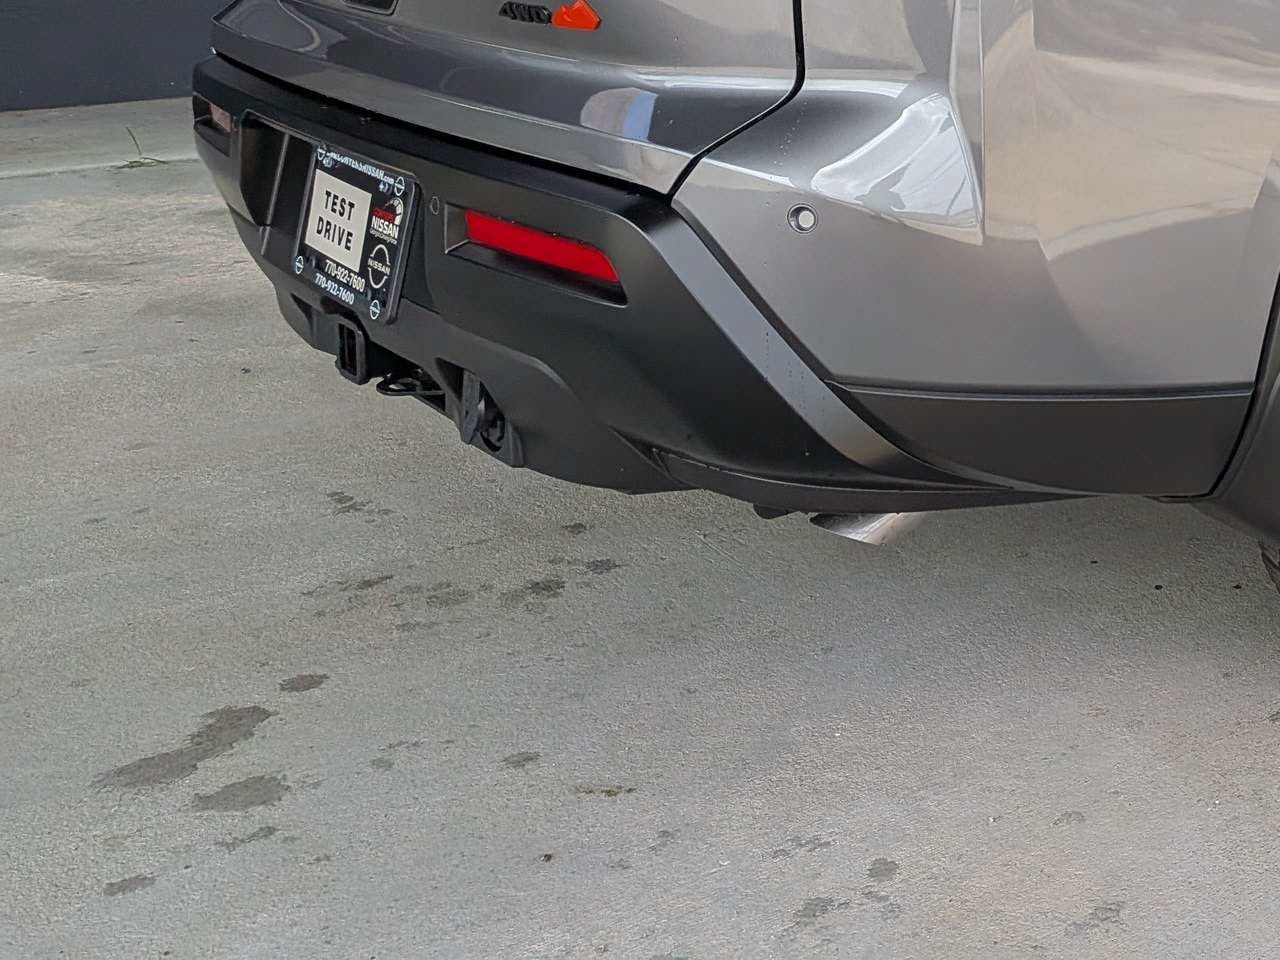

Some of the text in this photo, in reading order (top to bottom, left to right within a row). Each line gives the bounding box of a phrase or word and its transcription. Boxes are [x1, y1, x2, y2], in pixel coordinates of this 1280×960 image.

[325, 190, 356, 221] TEST
[316, 215, 354, 251] DRIVE
[371, 215, 399, 239] NISSAN
[325, 259, 366, 292] 770-922-7600
[367, 258, 391, 275] NISSAN
[315, 273, 355, 305] 770-922-7600
